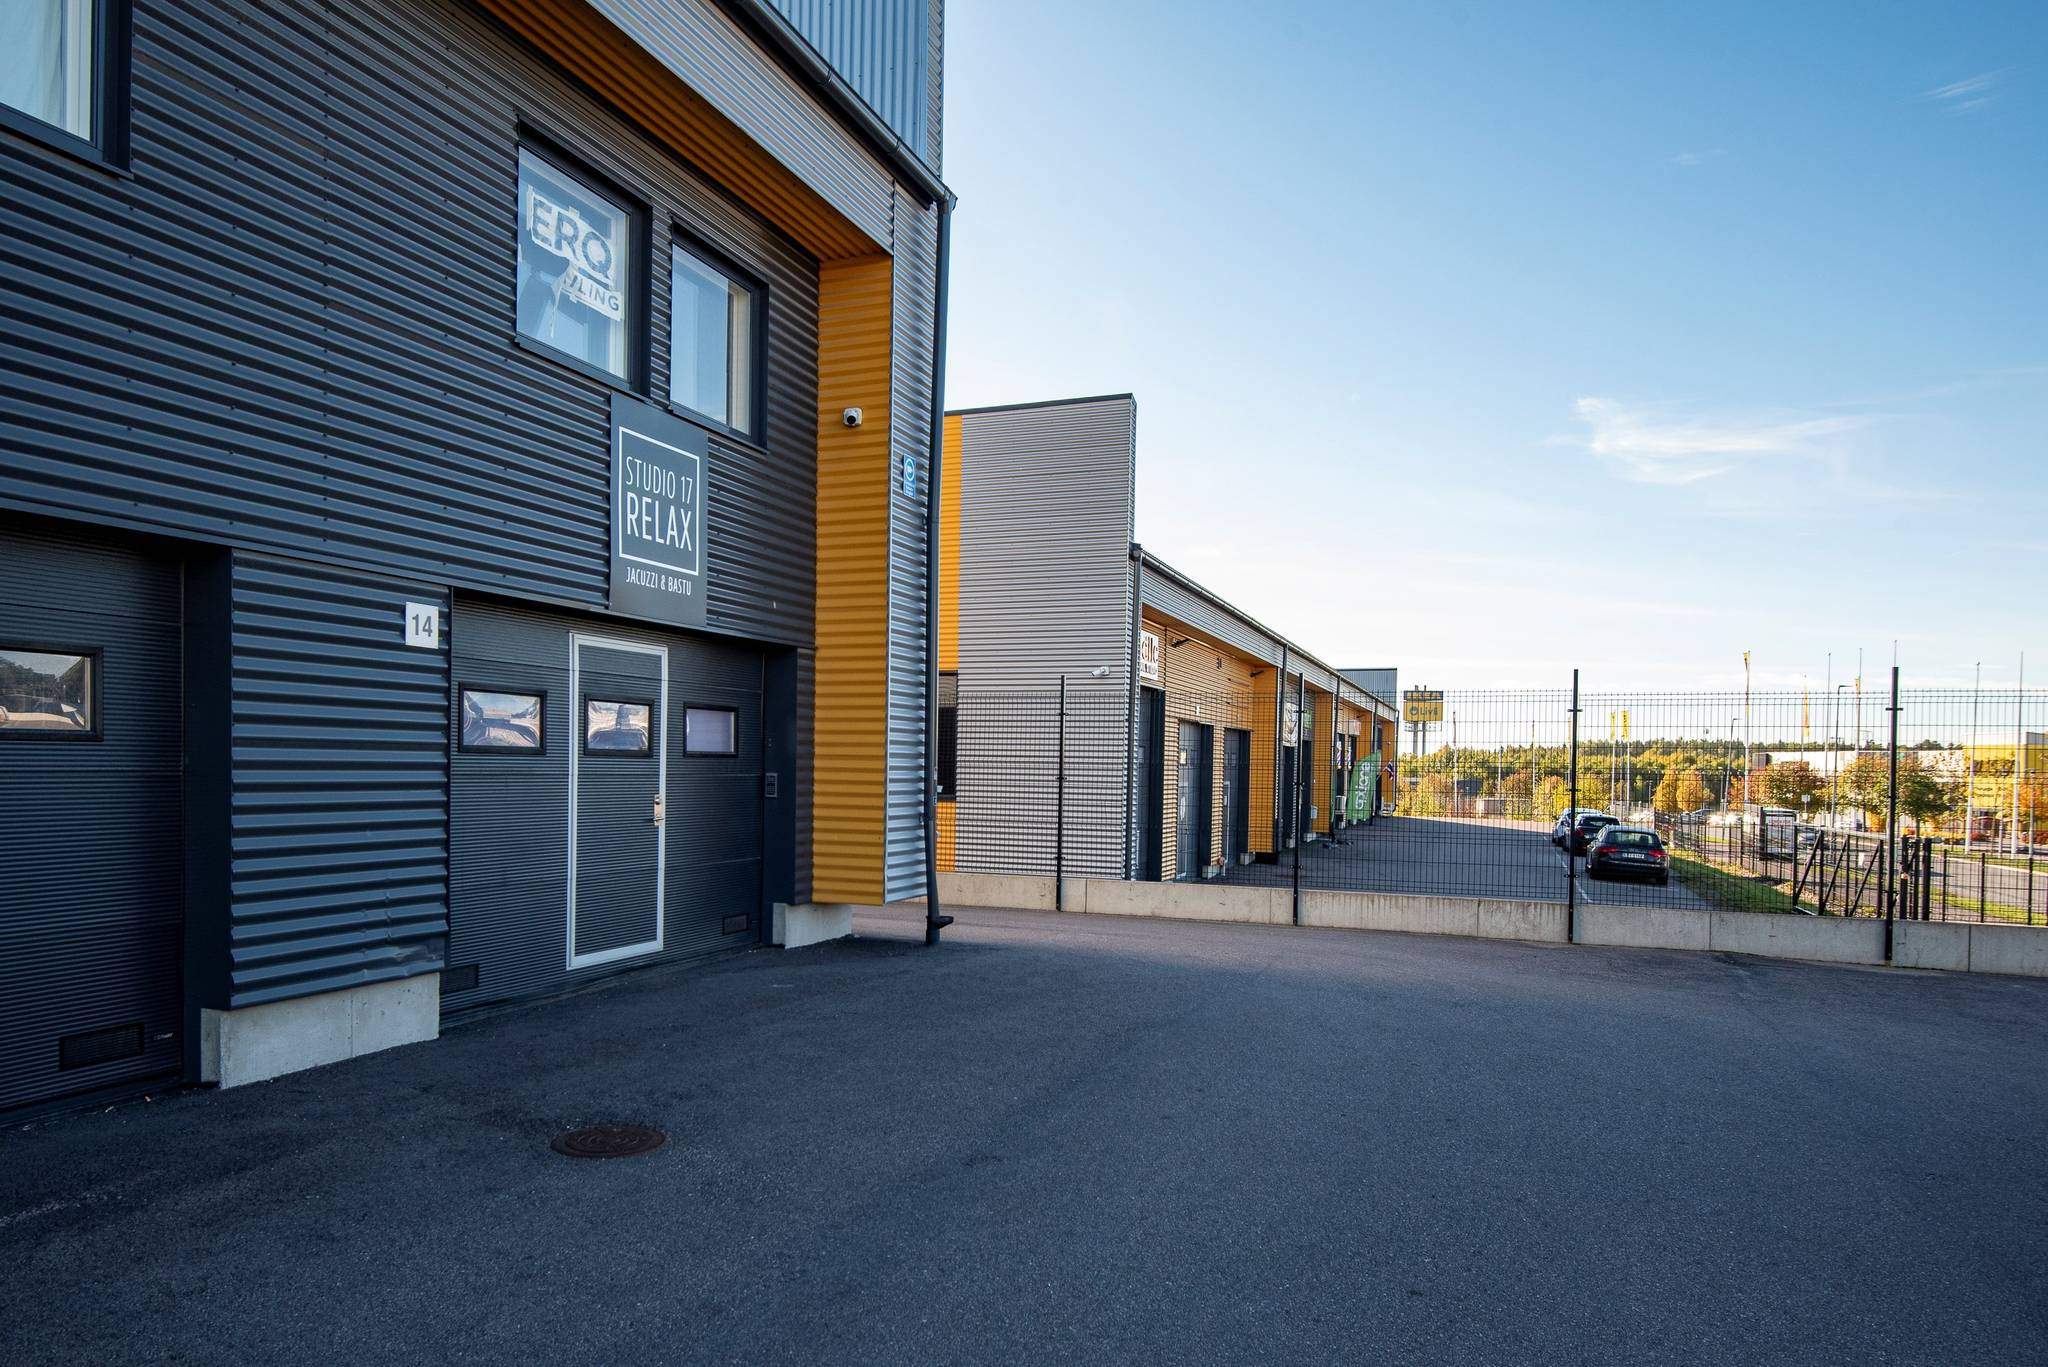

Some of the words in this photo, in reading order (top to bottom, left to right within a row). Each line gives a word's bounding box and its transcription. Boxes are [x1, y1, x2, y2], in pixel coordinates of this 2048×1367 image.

[626, 456, 675, 499] STUDIO
[681, 476, 693, 504] 17
[626, 491, 692, 551] RELAX
[626, 566, 658, 589] JACUZZI
[661, 576, 667, 590] &
[668, 577, 692, 596] BASTU
[412, 614, 433, 637] 14
